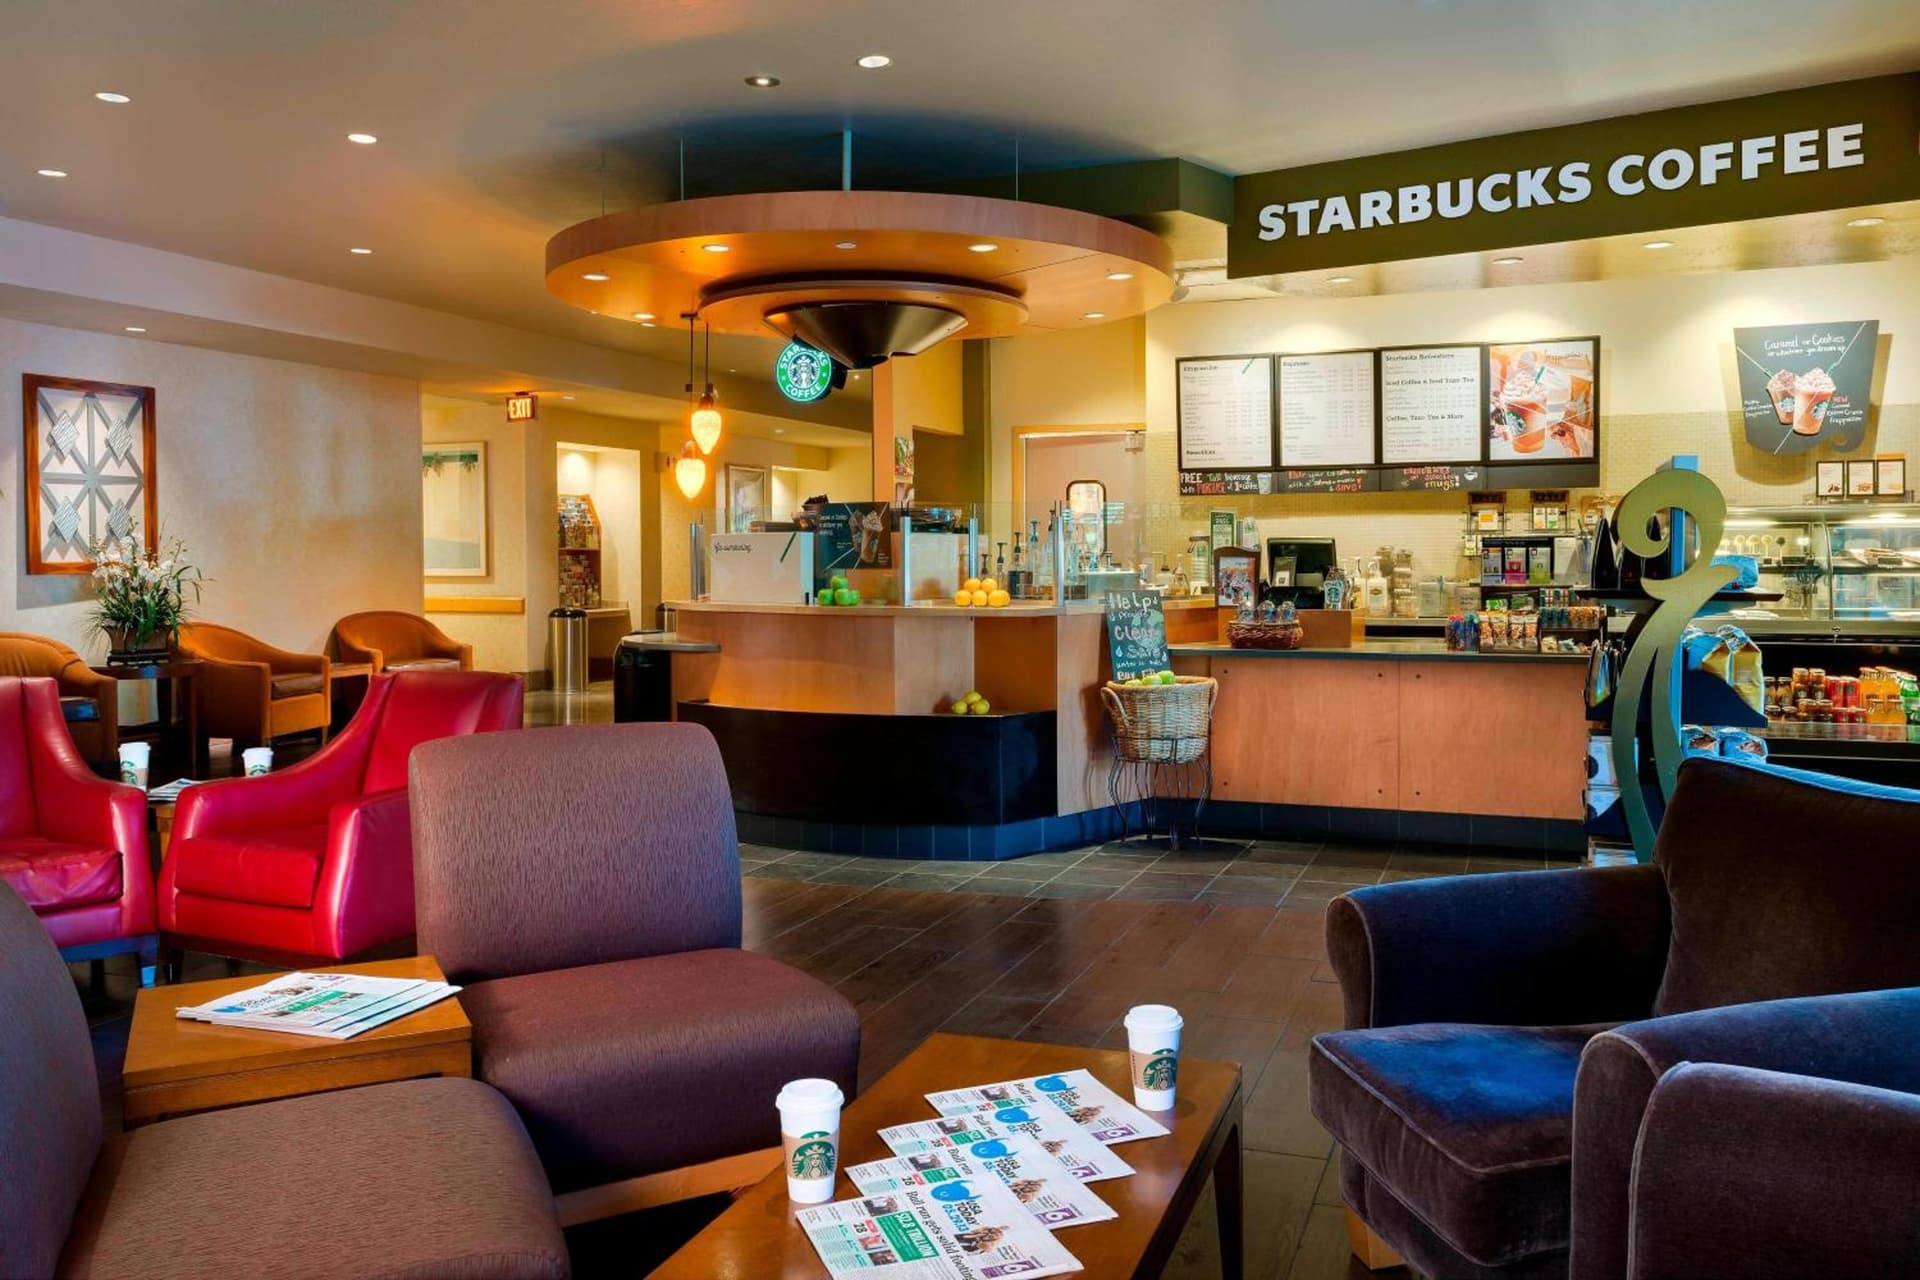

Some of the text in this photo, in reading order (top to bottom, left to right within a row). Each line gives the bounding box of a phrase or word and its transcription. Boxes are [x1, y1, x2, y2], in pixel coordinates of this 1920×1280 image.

[1258, 123, 1864, 241] STARBUCKS COFFEE
[1764, 334, 1798, 351] Caramel
[1812, 333, 1845, 346] Cookies
[785, 384, 823, 398] COFFEE
[508, 398, 532, 419] EXIT
[1180, 472, 1203, 483] FREE
[1109, 592, 1151, 613] Help
[995, 1159, 1018, 1179] TODAY
[1004, 1157, 1021, 1170] USA
[955, 1201, 979, 1225] TODAY
[966, 1199, 983, 1215] USA
[942, 1203, 970, 1232] 05.29.13
[853, 1222, 868, 1234] 28
[922, 1219, 942, 1235] gets
[937, 1235, 960, 1254] solid
[1003, 1263, 1030, 1275] 6
